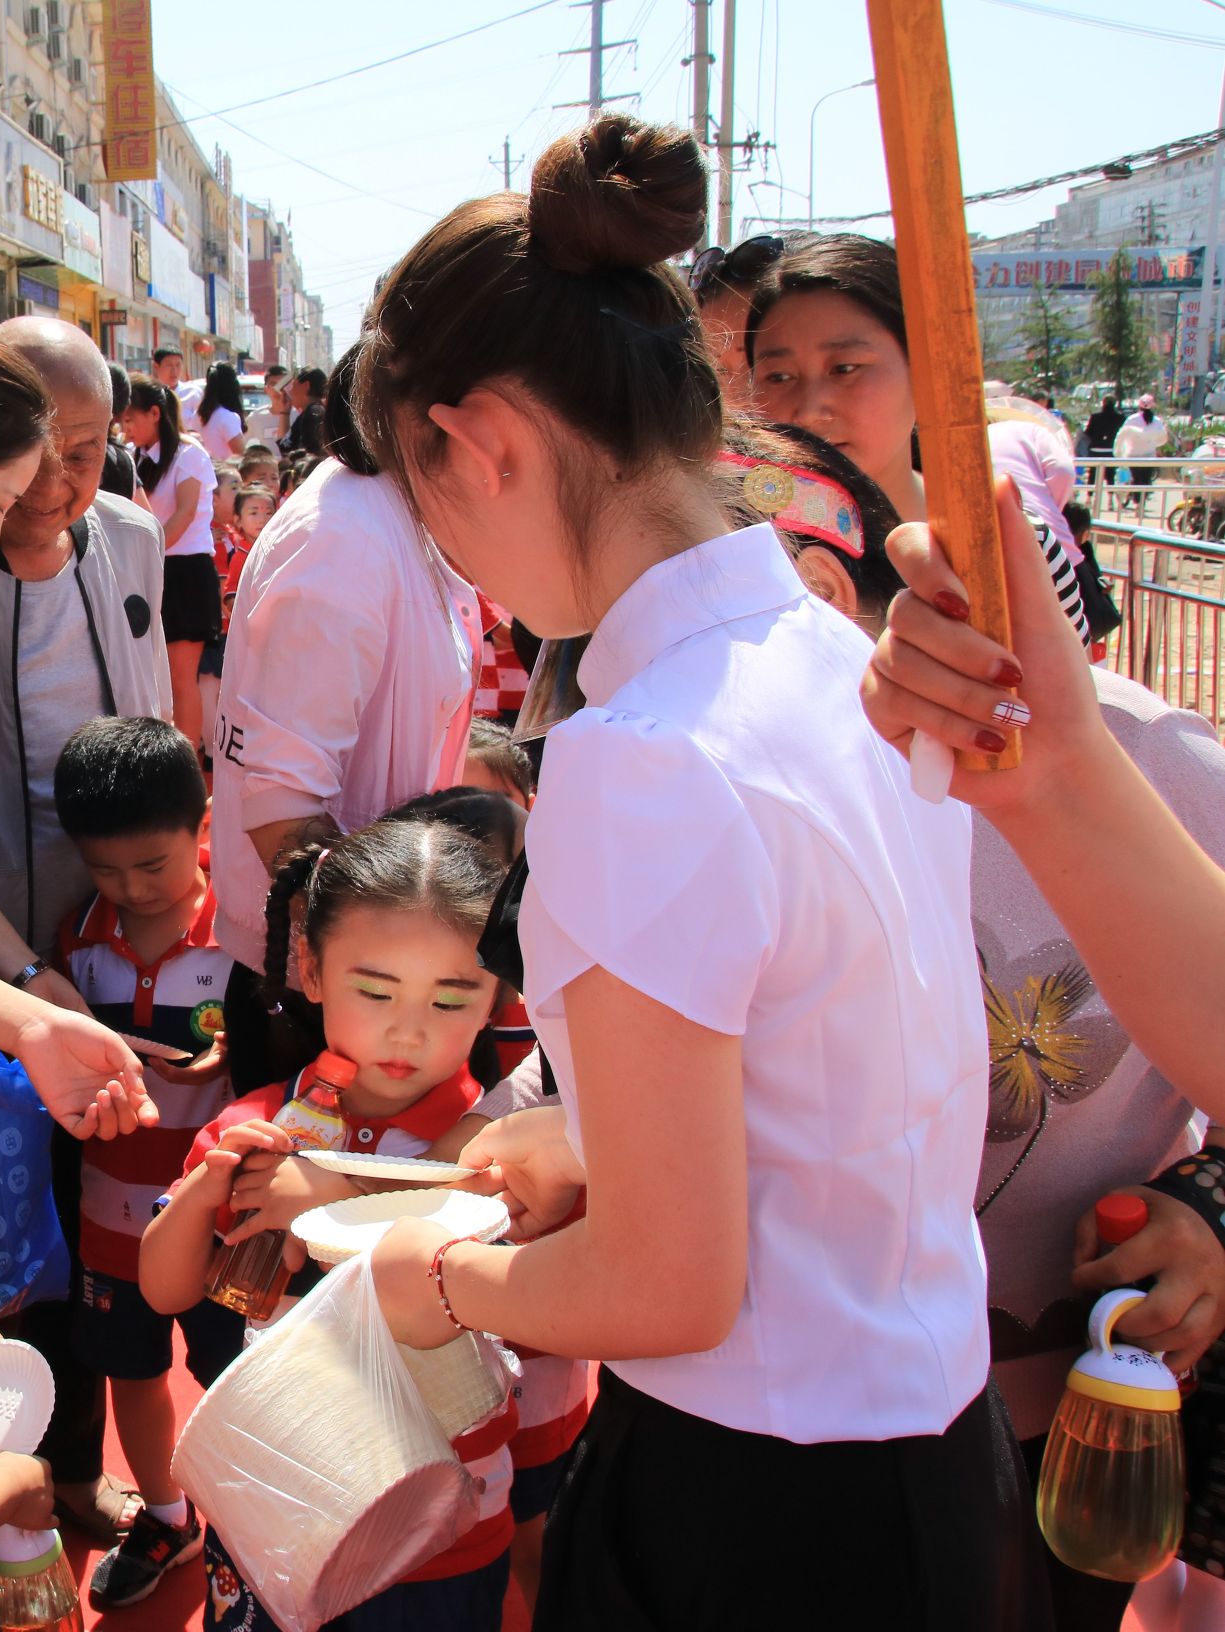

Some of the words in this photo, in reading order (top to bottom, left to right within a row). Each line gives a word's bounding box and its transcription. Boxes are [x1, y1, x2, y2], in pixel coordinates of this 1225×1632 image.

[972, 256, 1195, 289] 力创建园城市
[196, 975, 213, 986] WB
